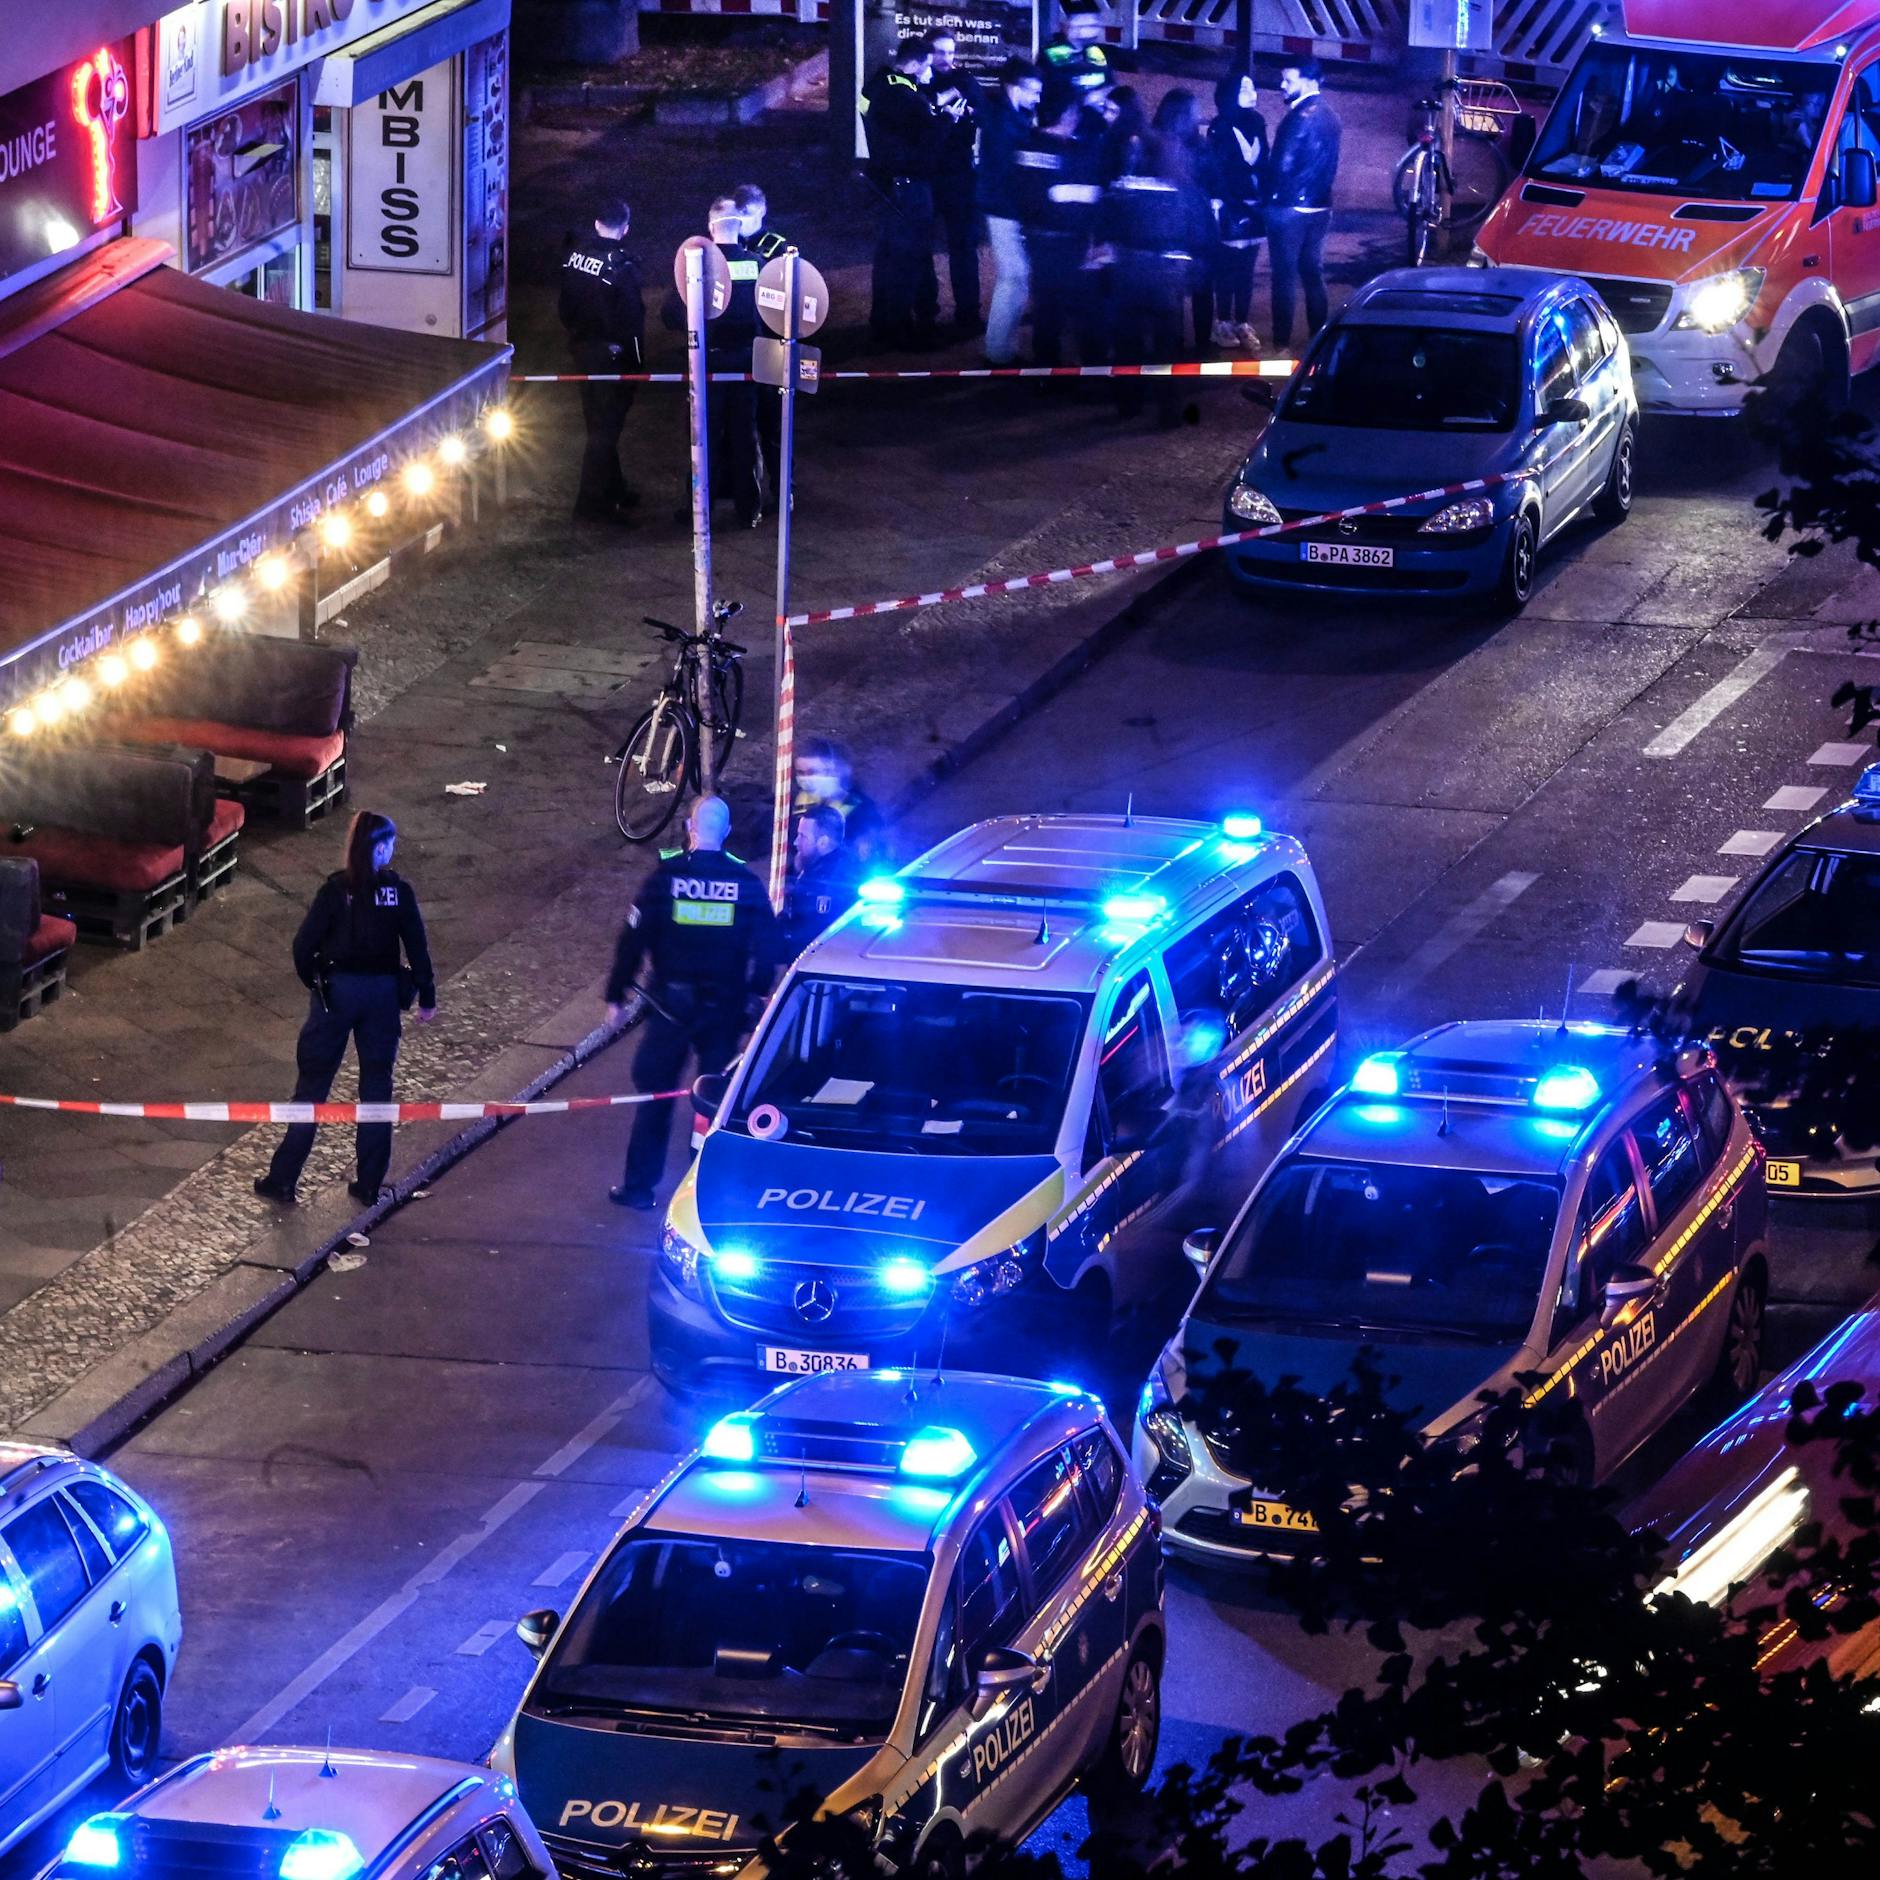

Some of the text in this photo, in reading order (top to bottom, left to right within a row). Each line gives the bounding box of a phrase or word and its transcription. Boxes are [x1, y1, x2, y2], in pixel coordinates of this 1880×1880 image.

[895, 13, 911, 26] Es
[913, 14, 933, 27] tut
[935, 15, 963, 28] sich
[965, 19, 993, 30] was
[955, 30, 1000, 45] benan
[0, 120, 57, 183] OUNGE
[379, 80, 424, 258] MBISS
[1517, 213, 1697, 252] FEUERWEHR
[568, 252, 605, 277] POLIZEI
[326, 474, 348, 506] Café
[1309, 545, 1391, 565] B PA 3862
[672, 877, 739, 901] POLIZEI
[1767, 1164, 1790, 1181] 05
[756, 1187, 926, 1221] POLIZEI
[775, 1351, 858, 1372] B 30836
[1600, 1310, 1656, 1385] POLIZEI
[1255, 1504, 1267, 1523] B
[973, 1696, 1035, 1784] POLIZEI
[558, 1799, 740, 1842] POLIZEI
